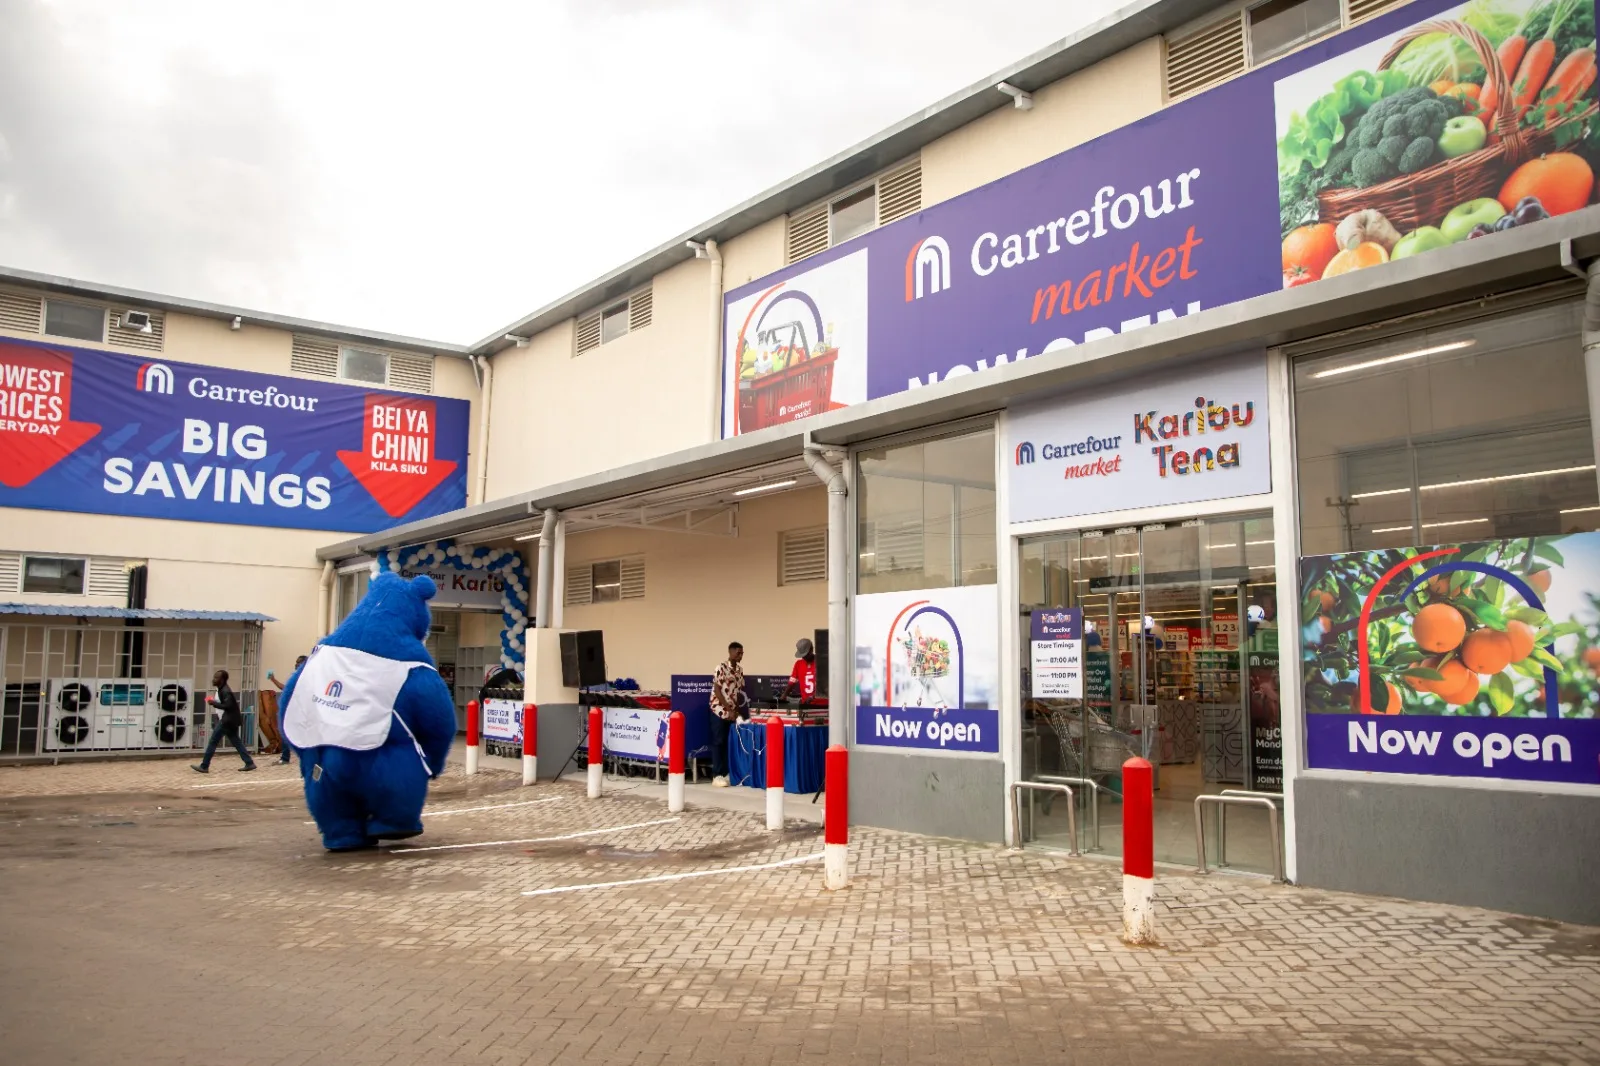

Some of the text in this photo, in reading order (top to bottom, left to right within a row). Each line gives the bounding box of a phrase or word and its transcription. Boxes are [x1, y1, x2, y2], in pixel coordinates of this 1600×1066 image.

[970, 167, 1201, 278] Carrefour
[1030, 226, 1204, 325] market
[188, 376, 318, 413] Carrefour
[372, 405, 429, 434] BEI YA
[1133, 395, 1254, 445] Karibu
[182, 417, 268, 460] BIG
[371, 431, 429, 463] CHINI
[1042, 435, 1122, 461] Carrefour
[370, 461, 428, 475] KILA SIKU
[1064, 454, 1122, 480] market
[1151, 441, 1241, 478] Tena
[103, 456, 332, 511] SAVINGS
[452, 573, 504, 593] Karib
[1053, 642, 1075, 650] Timings
[1068, 656, 1078, 664] AM
[805, 674, 814, 694] 5
[875, 713, 981, 747] Now open
[1347, 720, 1573, 768] Now open
[1256, 776, 1275, 784] JOIN
